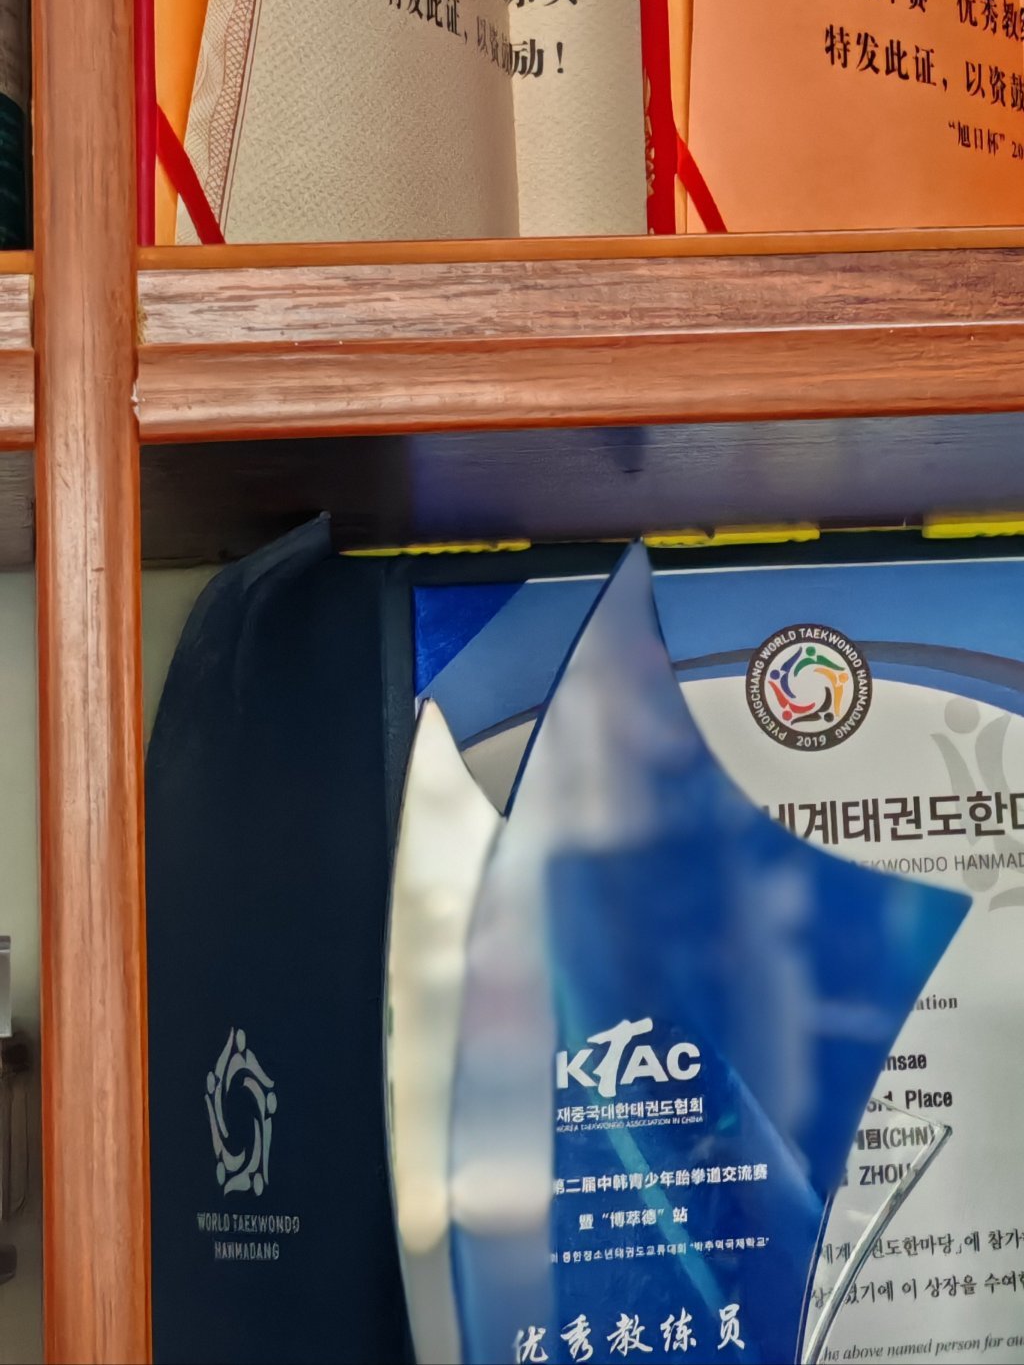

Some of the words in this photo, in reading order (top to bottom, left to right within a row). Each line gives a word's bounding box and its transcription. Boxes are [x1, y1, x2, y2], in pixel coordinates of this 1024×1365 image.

[759, 629, 797, 661] WORLD
[798, 626, 863, 669] TAEKWONDO
[749, 659, 788, 742] PYEONGCHANG
[834, 668, 870, 740] HANMADANG
[795, 734, 827, 748] 2019
[555, 1017, 702, 1098] KTAC
[904, 1088, 954, 1110] Place
[196, 1211, 230, 1233] WORLD
[231, 1213, 301, 1235] TAEKWONDO
[213, 1240, 281, 1262] HANMADANG
[901, 1278, 918, 1302] 이
[923, 1273, 977, 1299] 상장을
[515, 1302, 746, 1365] 优秀教练员
[842, 1343, 884, 1361] above
[886, 1337, 932, 1358] named
[935, 1336, 981, 1357] person
[982, 1332, 1004, 1352] for
